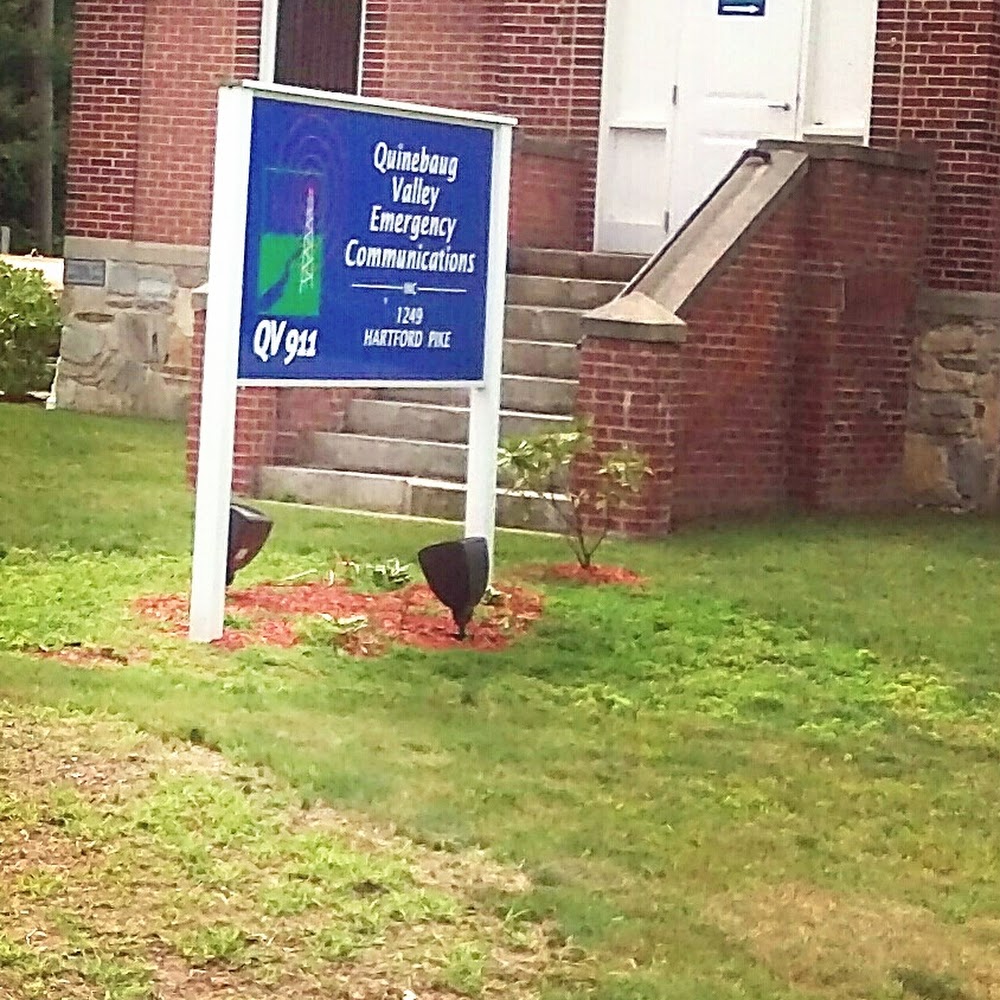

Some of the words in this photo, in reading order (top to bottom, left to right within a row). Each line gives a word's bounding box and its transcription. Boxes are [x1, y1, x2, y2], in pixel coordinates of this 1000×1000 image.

[373, 141, 458, 182] Quinebaug
[392, 177, 440, 212] Valley
[369, 205, 457, 243] Emergency
[345, 239, 476, 273] Communications
[397, 306, 423, 325] 1249
[284, 328, 318, 365] 911
[364, 328, 423, 348] HARTFORD
